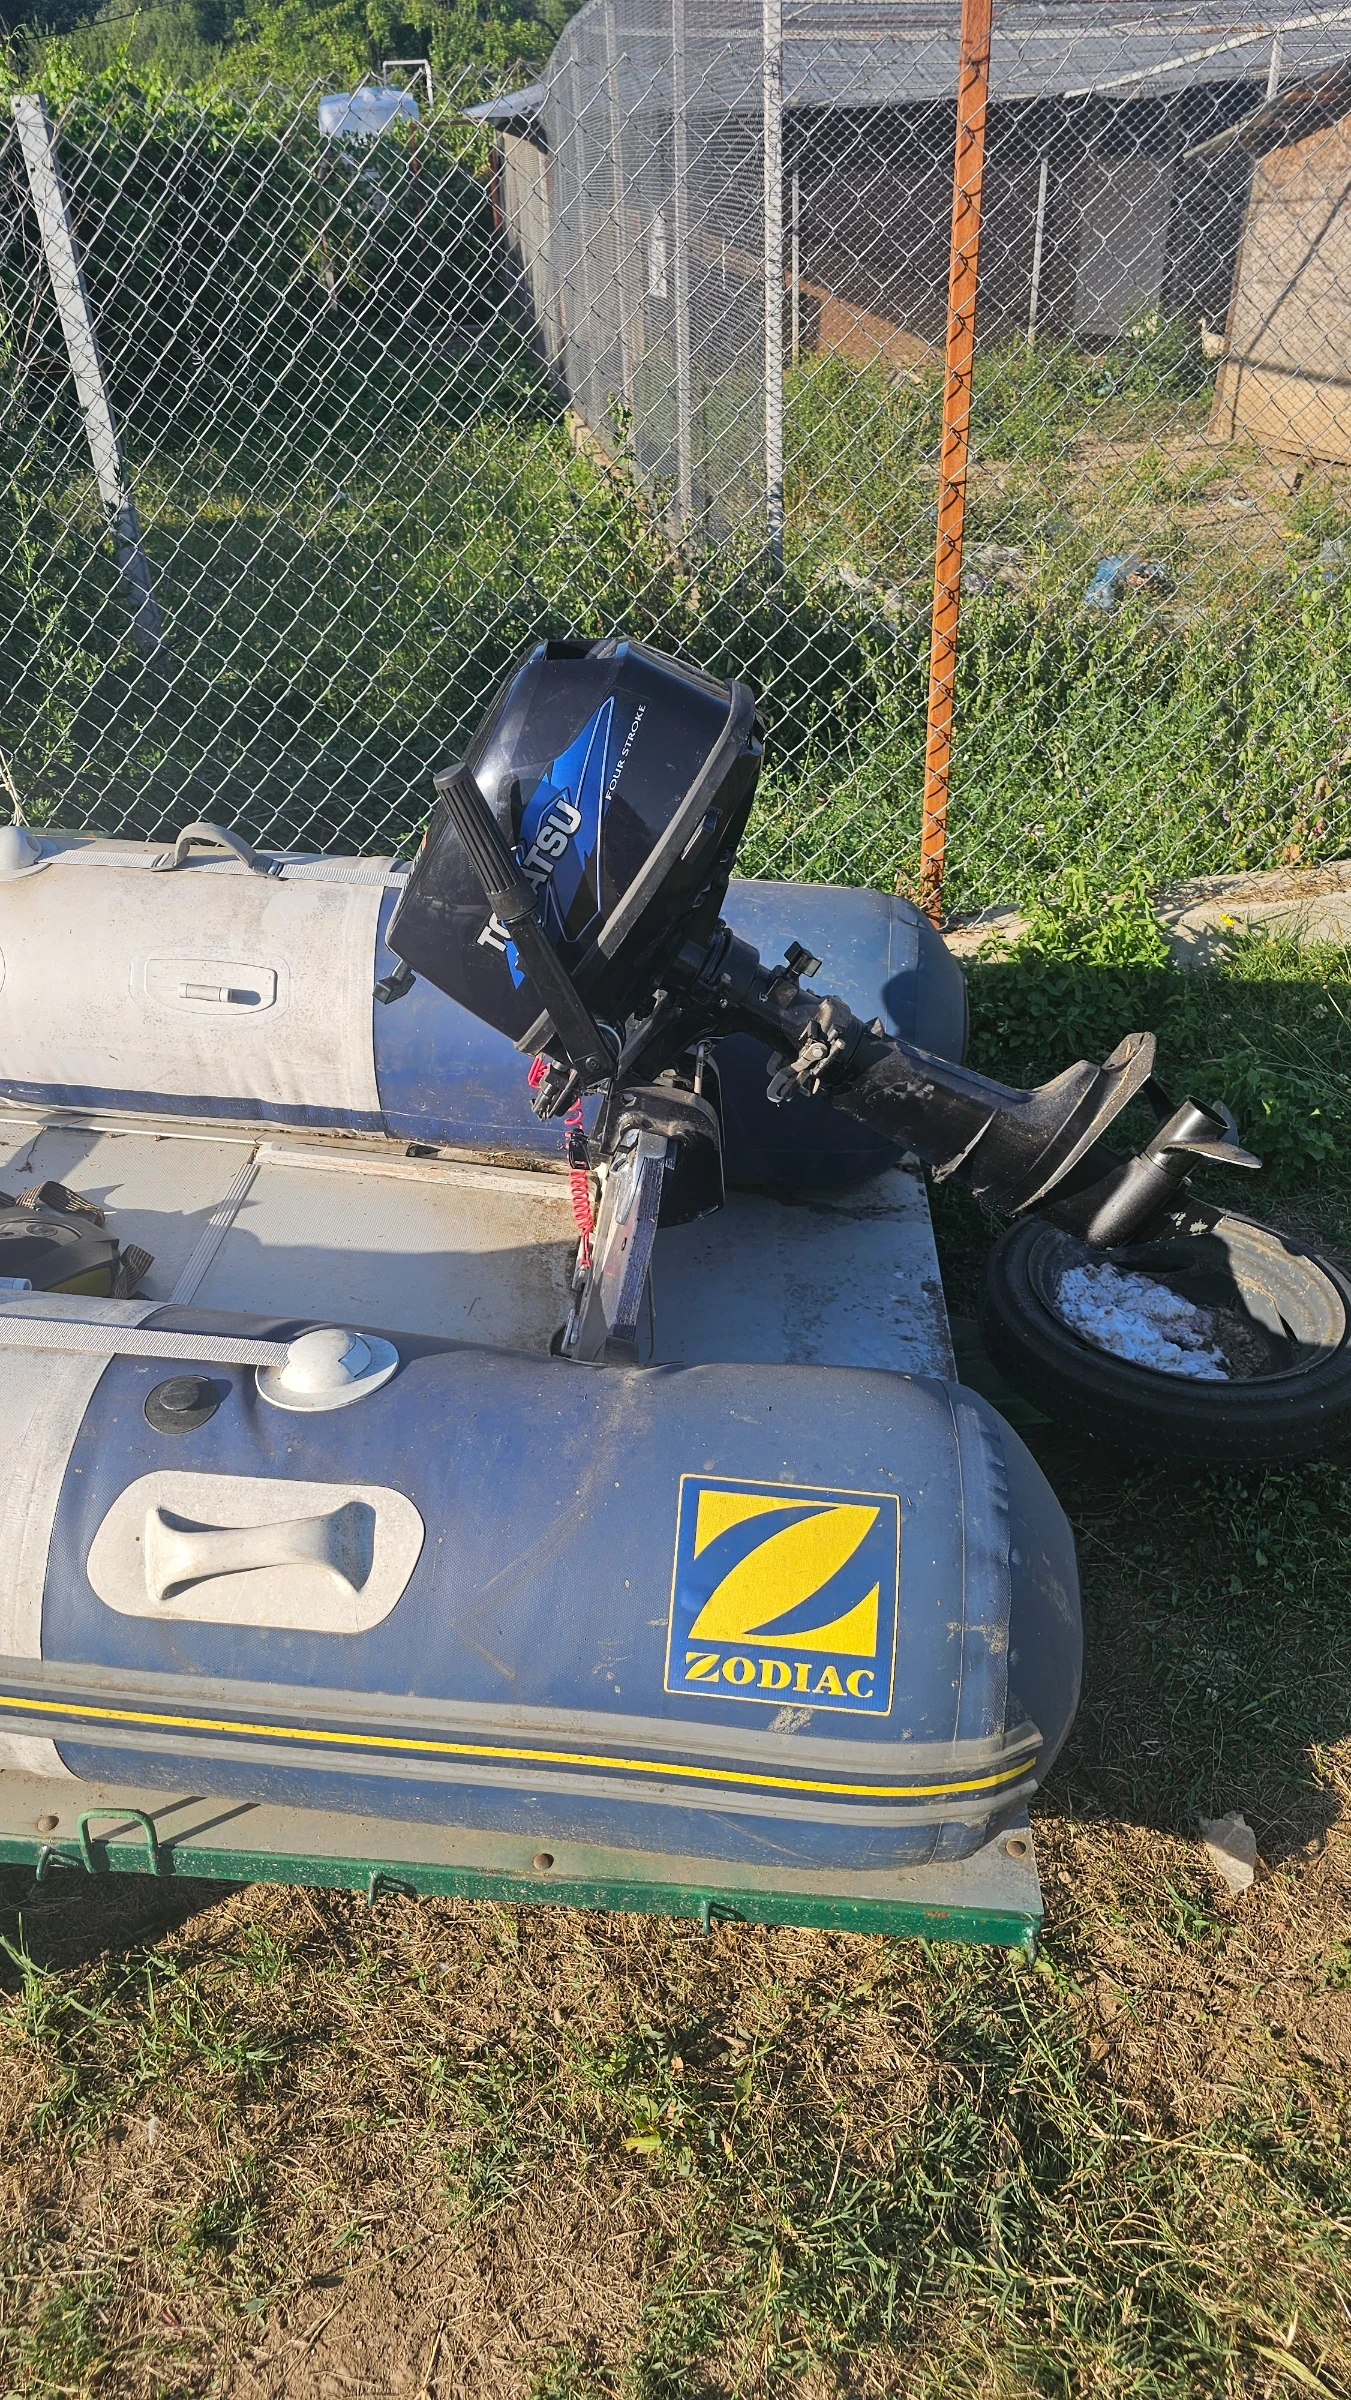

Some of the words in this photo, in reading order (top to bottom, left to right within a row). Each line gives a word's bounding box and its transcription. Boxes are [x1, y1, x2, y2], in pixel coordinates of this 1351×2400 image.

[605, 759, 626, 801] FOUR
[621, 704, 647, 757] STROKE
[476, 799, 582, 953] TATSU
[684, 1651, 875, 1698] ZODIAC
